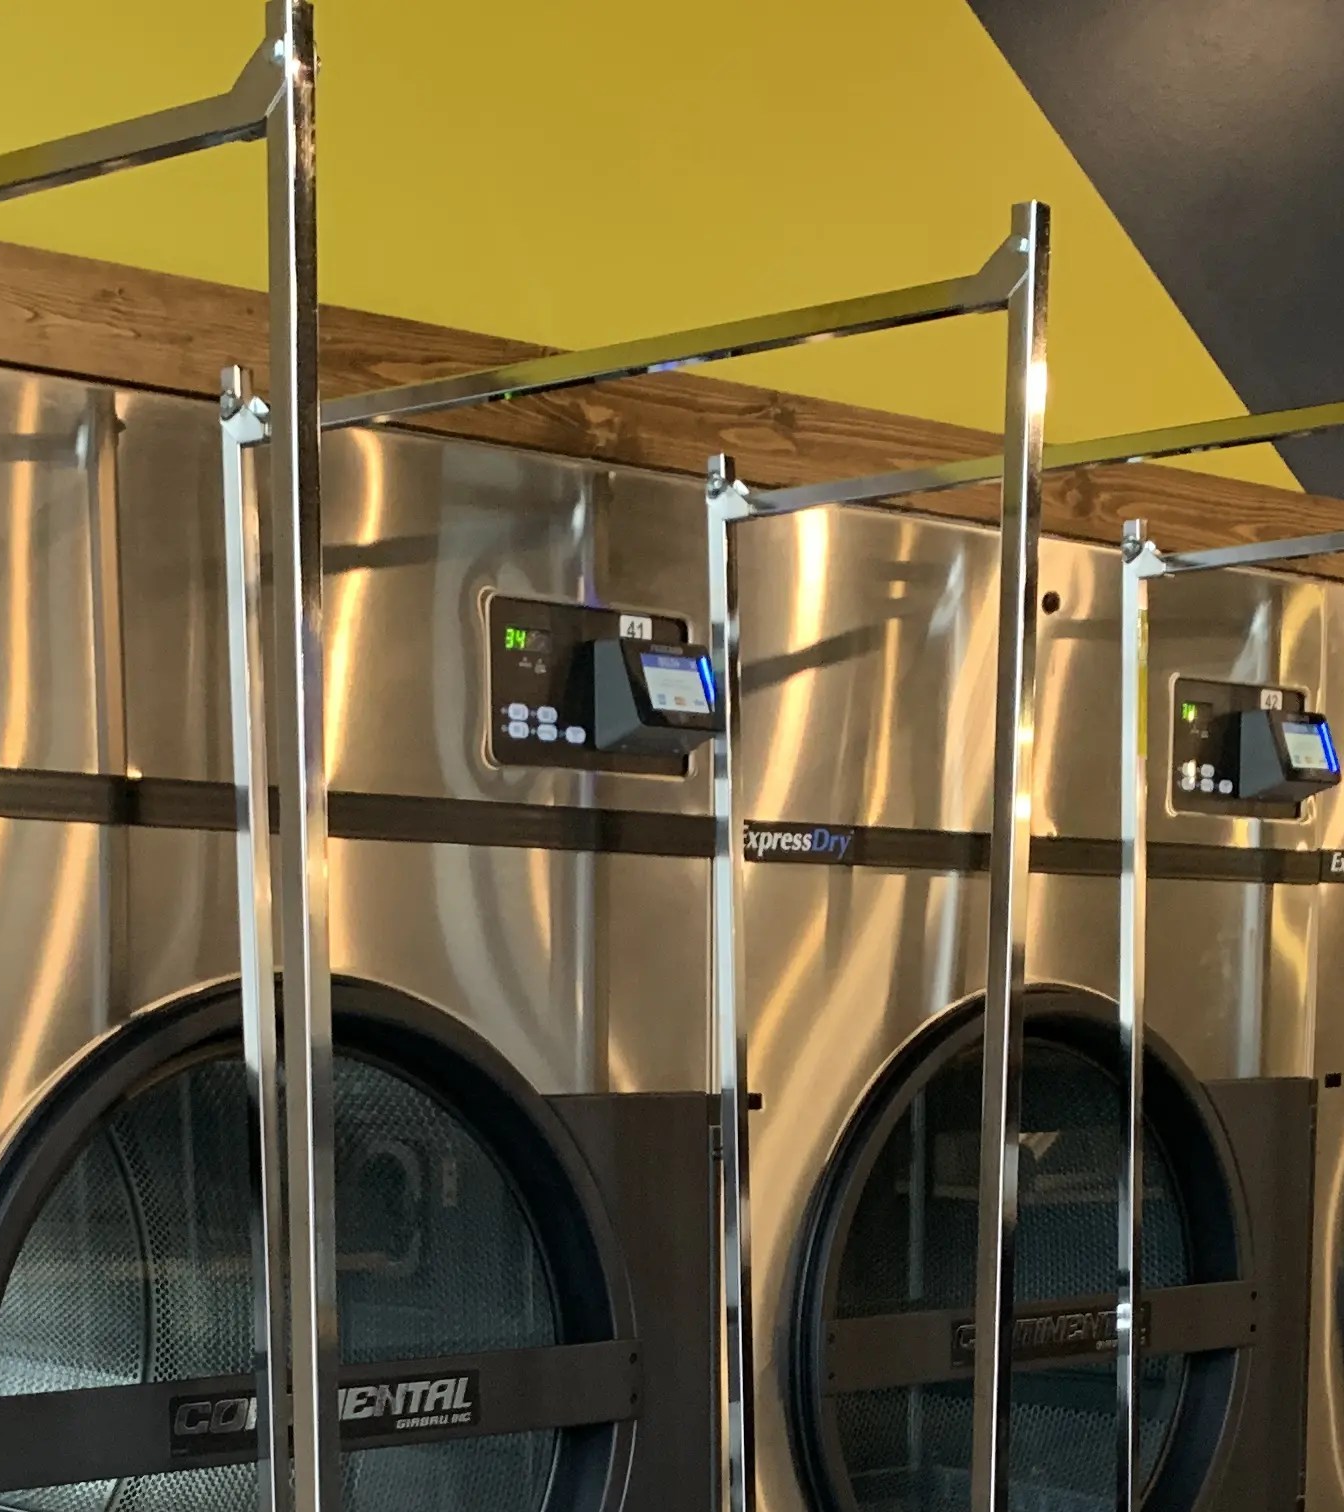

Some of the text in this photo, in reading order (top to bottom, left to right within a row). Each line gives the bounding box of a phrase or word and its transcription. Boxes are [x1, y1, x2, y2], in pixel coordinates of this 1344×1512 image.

[506, 629, 526, 648] 34
[627, 621, 644, 639] 41
[173, 1377, 472, 1436] COENTAL
